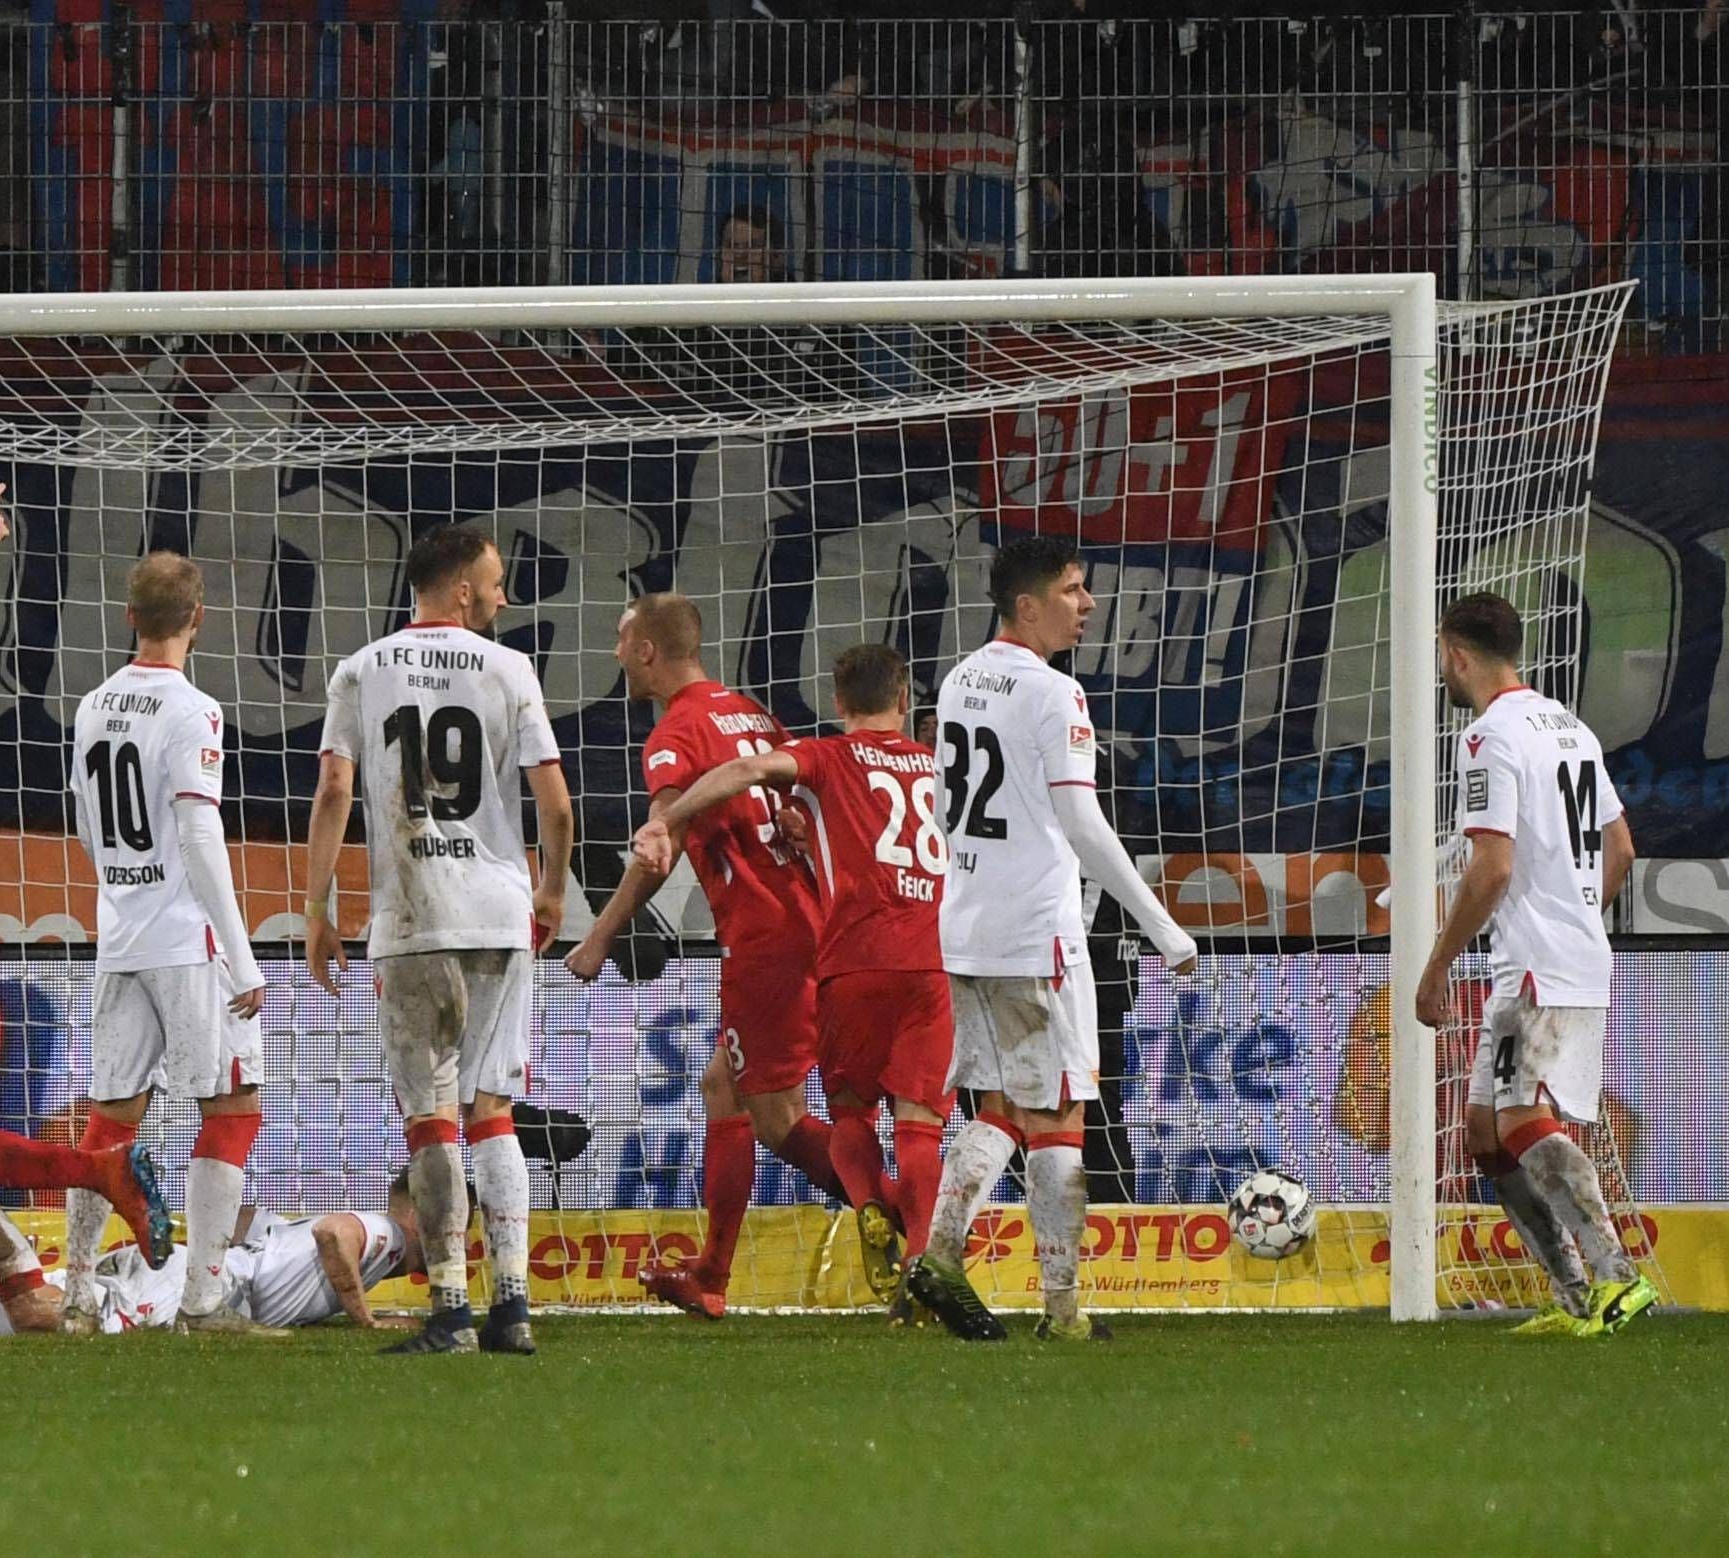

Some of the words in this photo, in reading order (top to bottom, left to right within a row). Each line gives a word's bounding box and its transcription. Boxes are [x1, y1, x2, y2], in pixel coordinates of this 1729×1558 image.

[1424, 366, 1437, 495] VINDICO
[374, 651, 388, 667] 1.
[393, 648, 414, 666] FC
[420, 651, 484, 672] UNION
[408, 674, 450, 690] BERLIN
[976, 670, 1017, 696] UNION
[101, 692, 116, 712] FC
[119, 694, 163, 716] UNION
[383, 705, 482, 821] 19
[851, 743, 934, 773] HEIDENHEI
[943, 721, 1007, 840] 32
[85, 740, 154, 852] 10
[1557, 760, 1601, 869] 14
[868, 771, 948, 875] 28
[898, 869, 934, 902] FEICK
[529, 1233, 701, 1281] OTTO
[1033, 1213, 1231, 1262] OTTO
